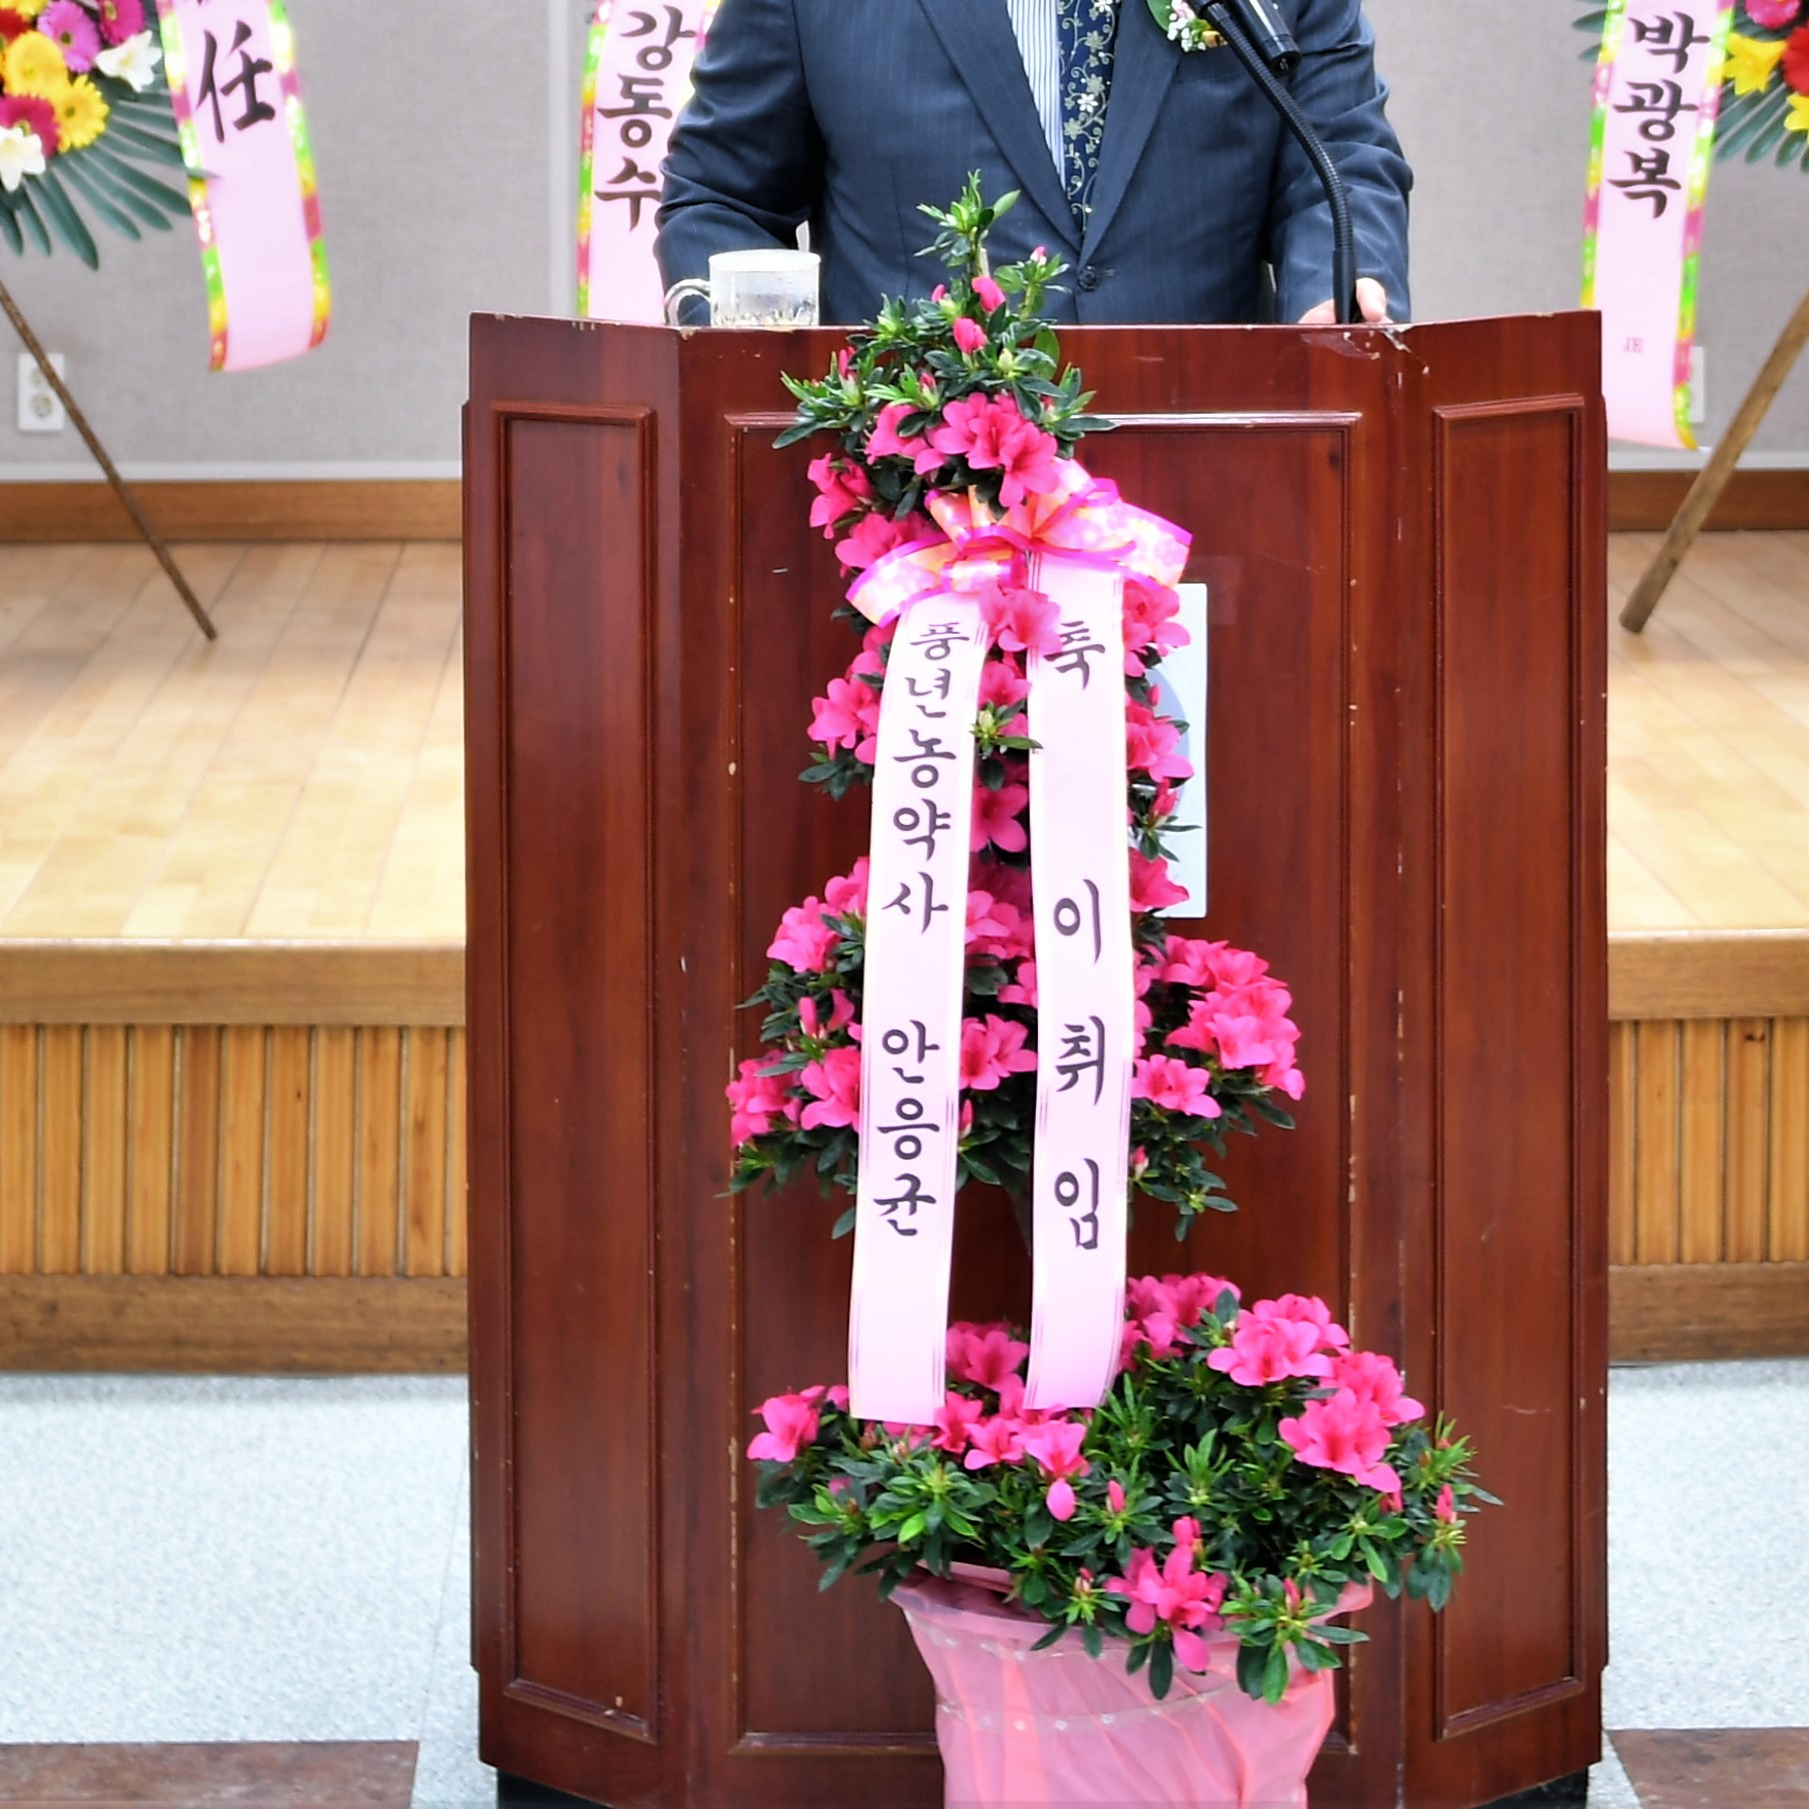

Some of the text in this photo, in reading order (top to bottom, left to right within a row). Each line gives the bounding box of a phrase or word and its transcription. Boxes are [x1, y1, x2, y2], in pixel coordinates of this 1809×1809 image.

[593, 4, 697, 232] 강동수
[1607, 10, 1711, 220] 박광복
[1043, 620, 1107, 690] 축
[873, 620, 973, 1238] 풍년농약사 안응균
